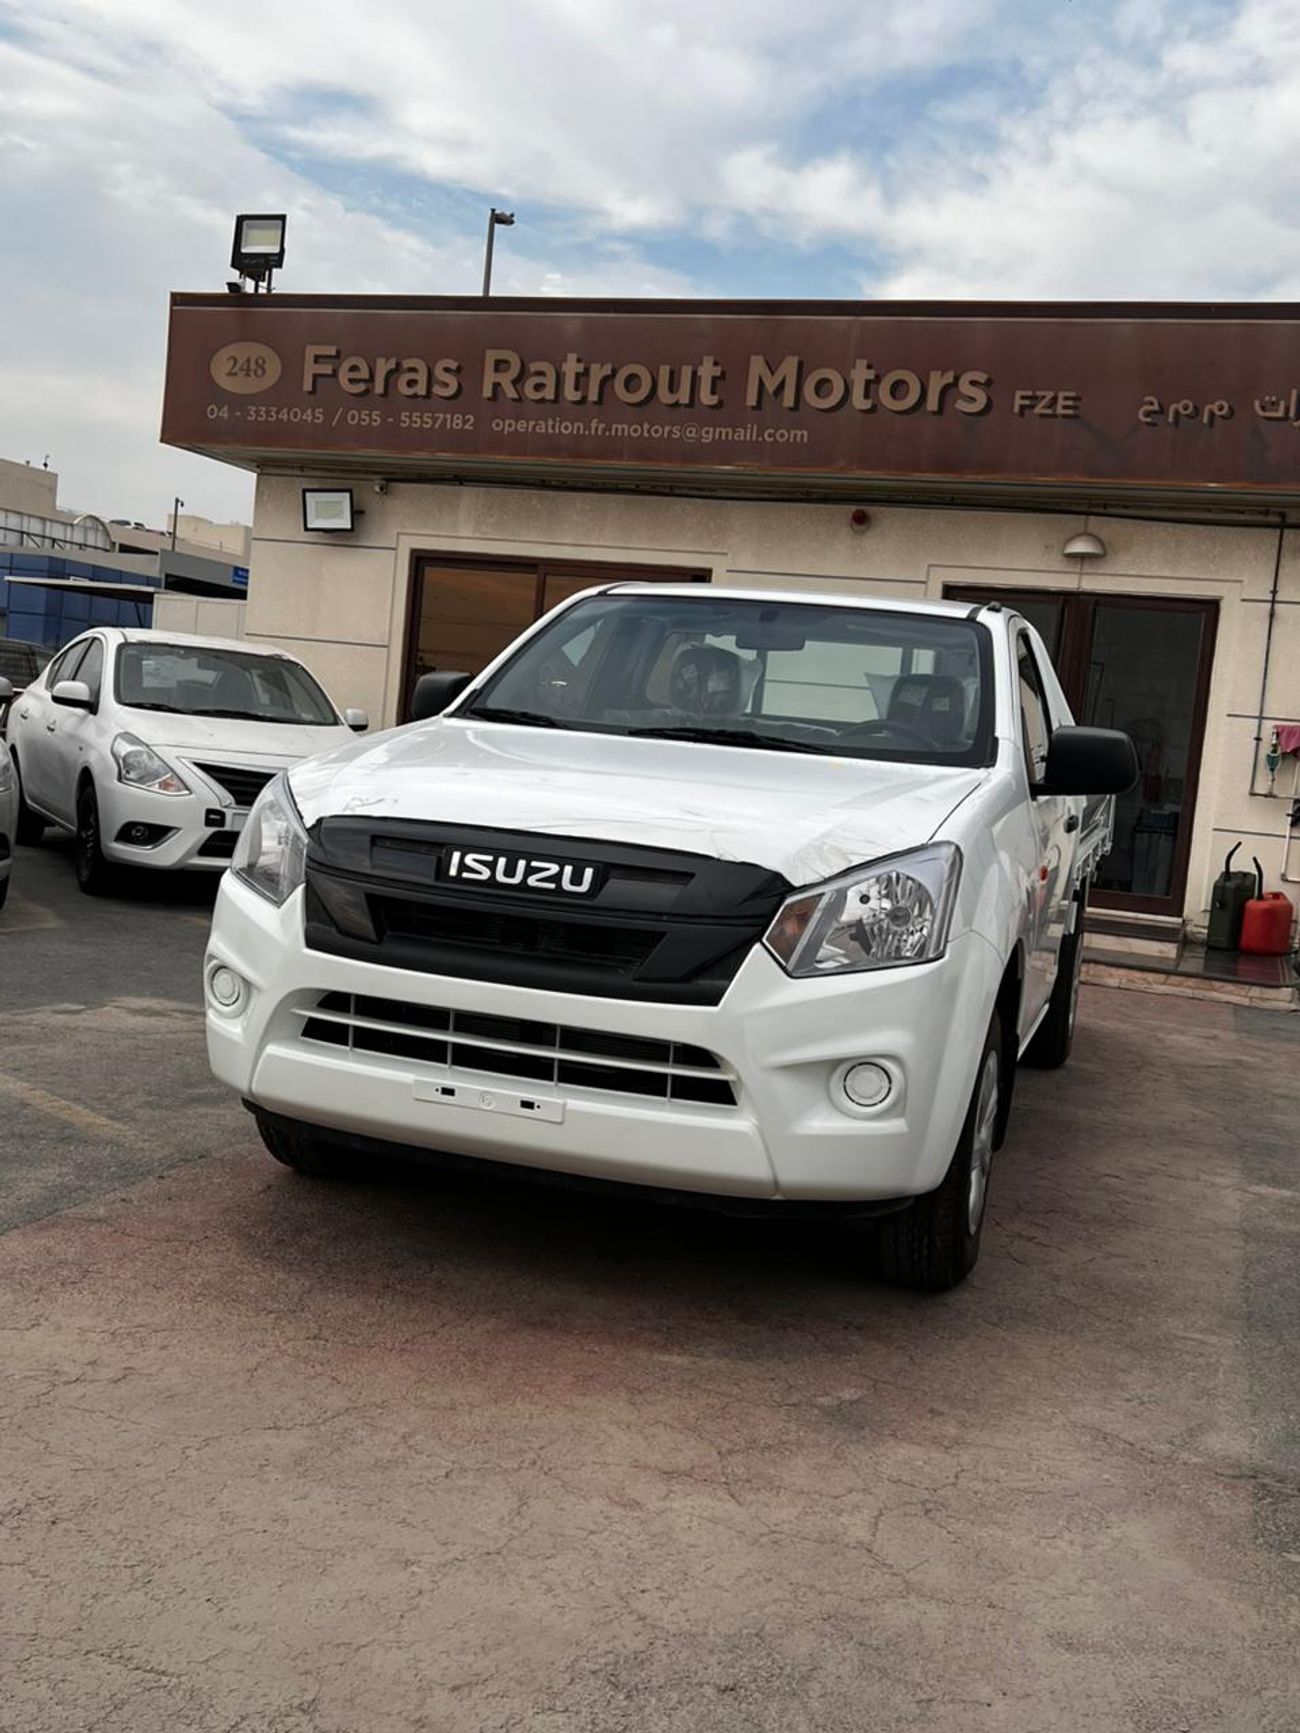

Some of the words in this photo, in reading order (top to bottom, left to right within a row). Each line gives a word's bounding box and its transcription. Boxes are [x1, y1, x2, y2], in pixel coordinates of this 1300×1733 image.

[225, 355, 267, 378] 248
[302, 344, 462, 398] Feras
[481, 349, 723, 406] Ratrout
[745, 354, 991, 414] Motors
[1012, 390, 1077, 415] FZE
[206, 403, 229, 420] 04
[246, 405, 324, 424] 3334045
[347, 409, 381, 427] 055
[399, 411, 475, 430] 5557182
[491, 416, 809, 444] operation.fr.motors@gmail.com
[448, 850, 594, 893] ISUZU
